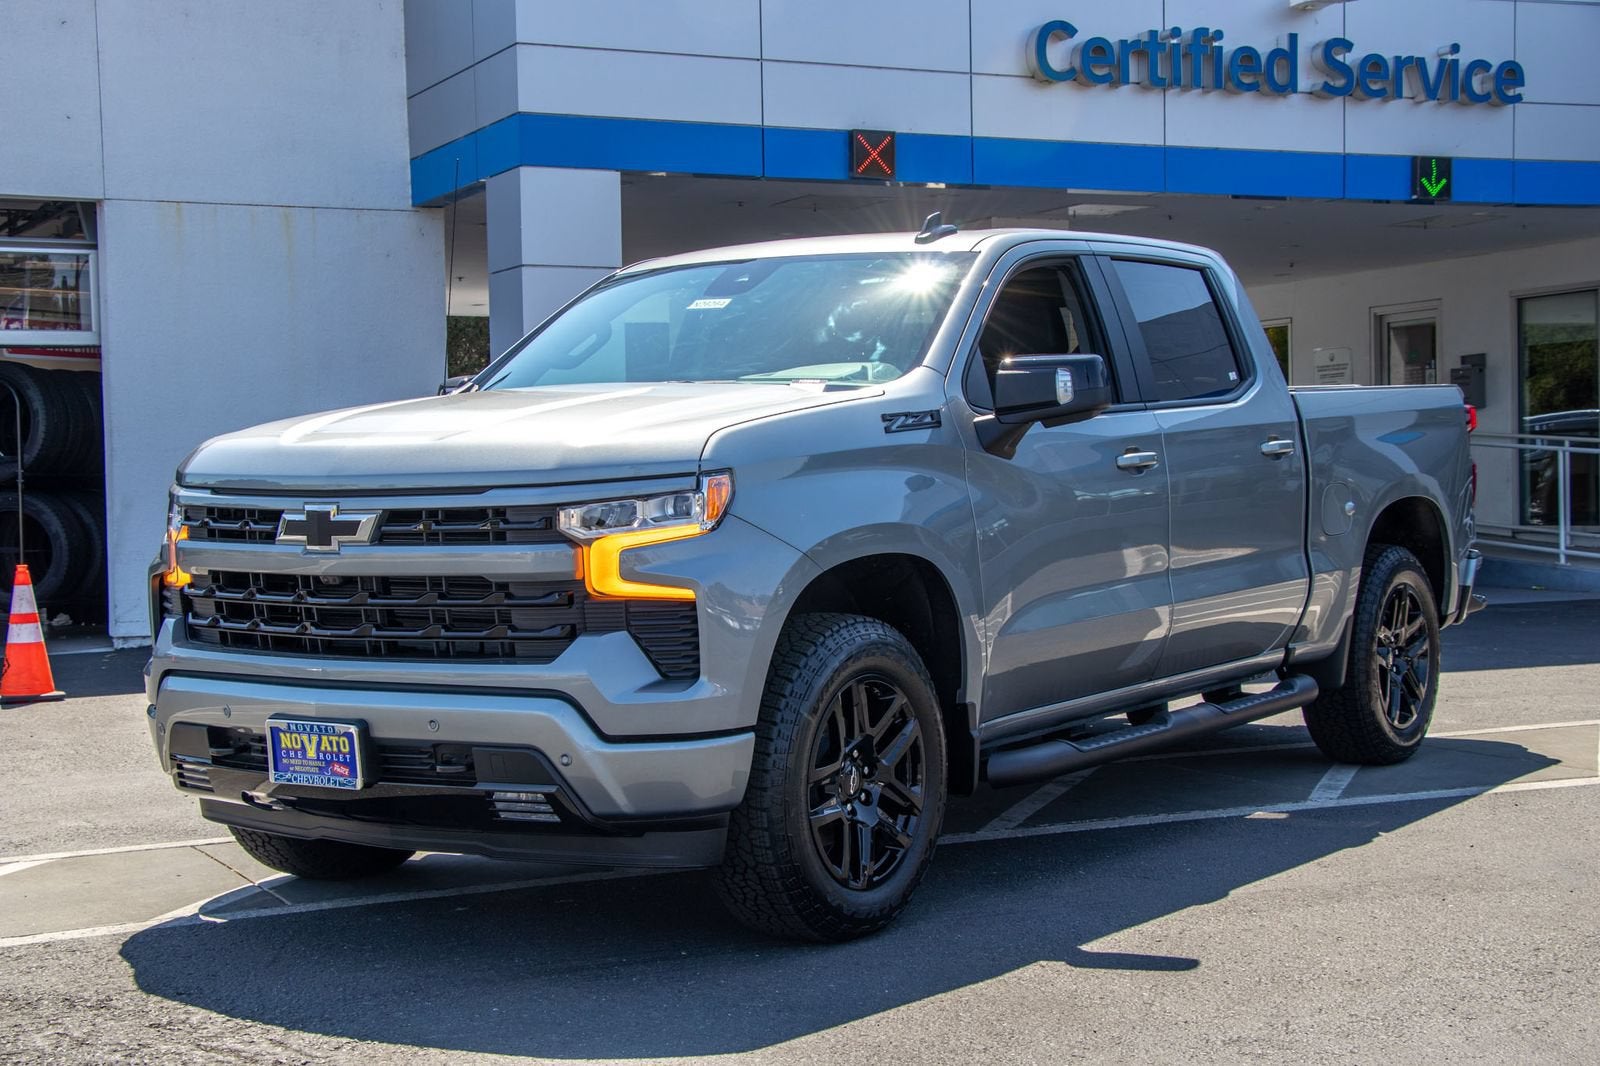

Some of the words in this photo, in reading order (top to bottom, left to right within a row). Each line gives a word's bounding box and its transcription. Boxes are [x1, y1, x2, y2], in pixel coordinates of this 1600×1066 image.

[1034, 19, 1299, 95] Certified
[1320, 37, 1526, 103] Service
[880, 409, 942, 434] Z71
[289, 723, 334, 734] NOVATO
[279, 732, 350, 760] NOVATO
[291, 774, 340, 787] CHEVROLET
